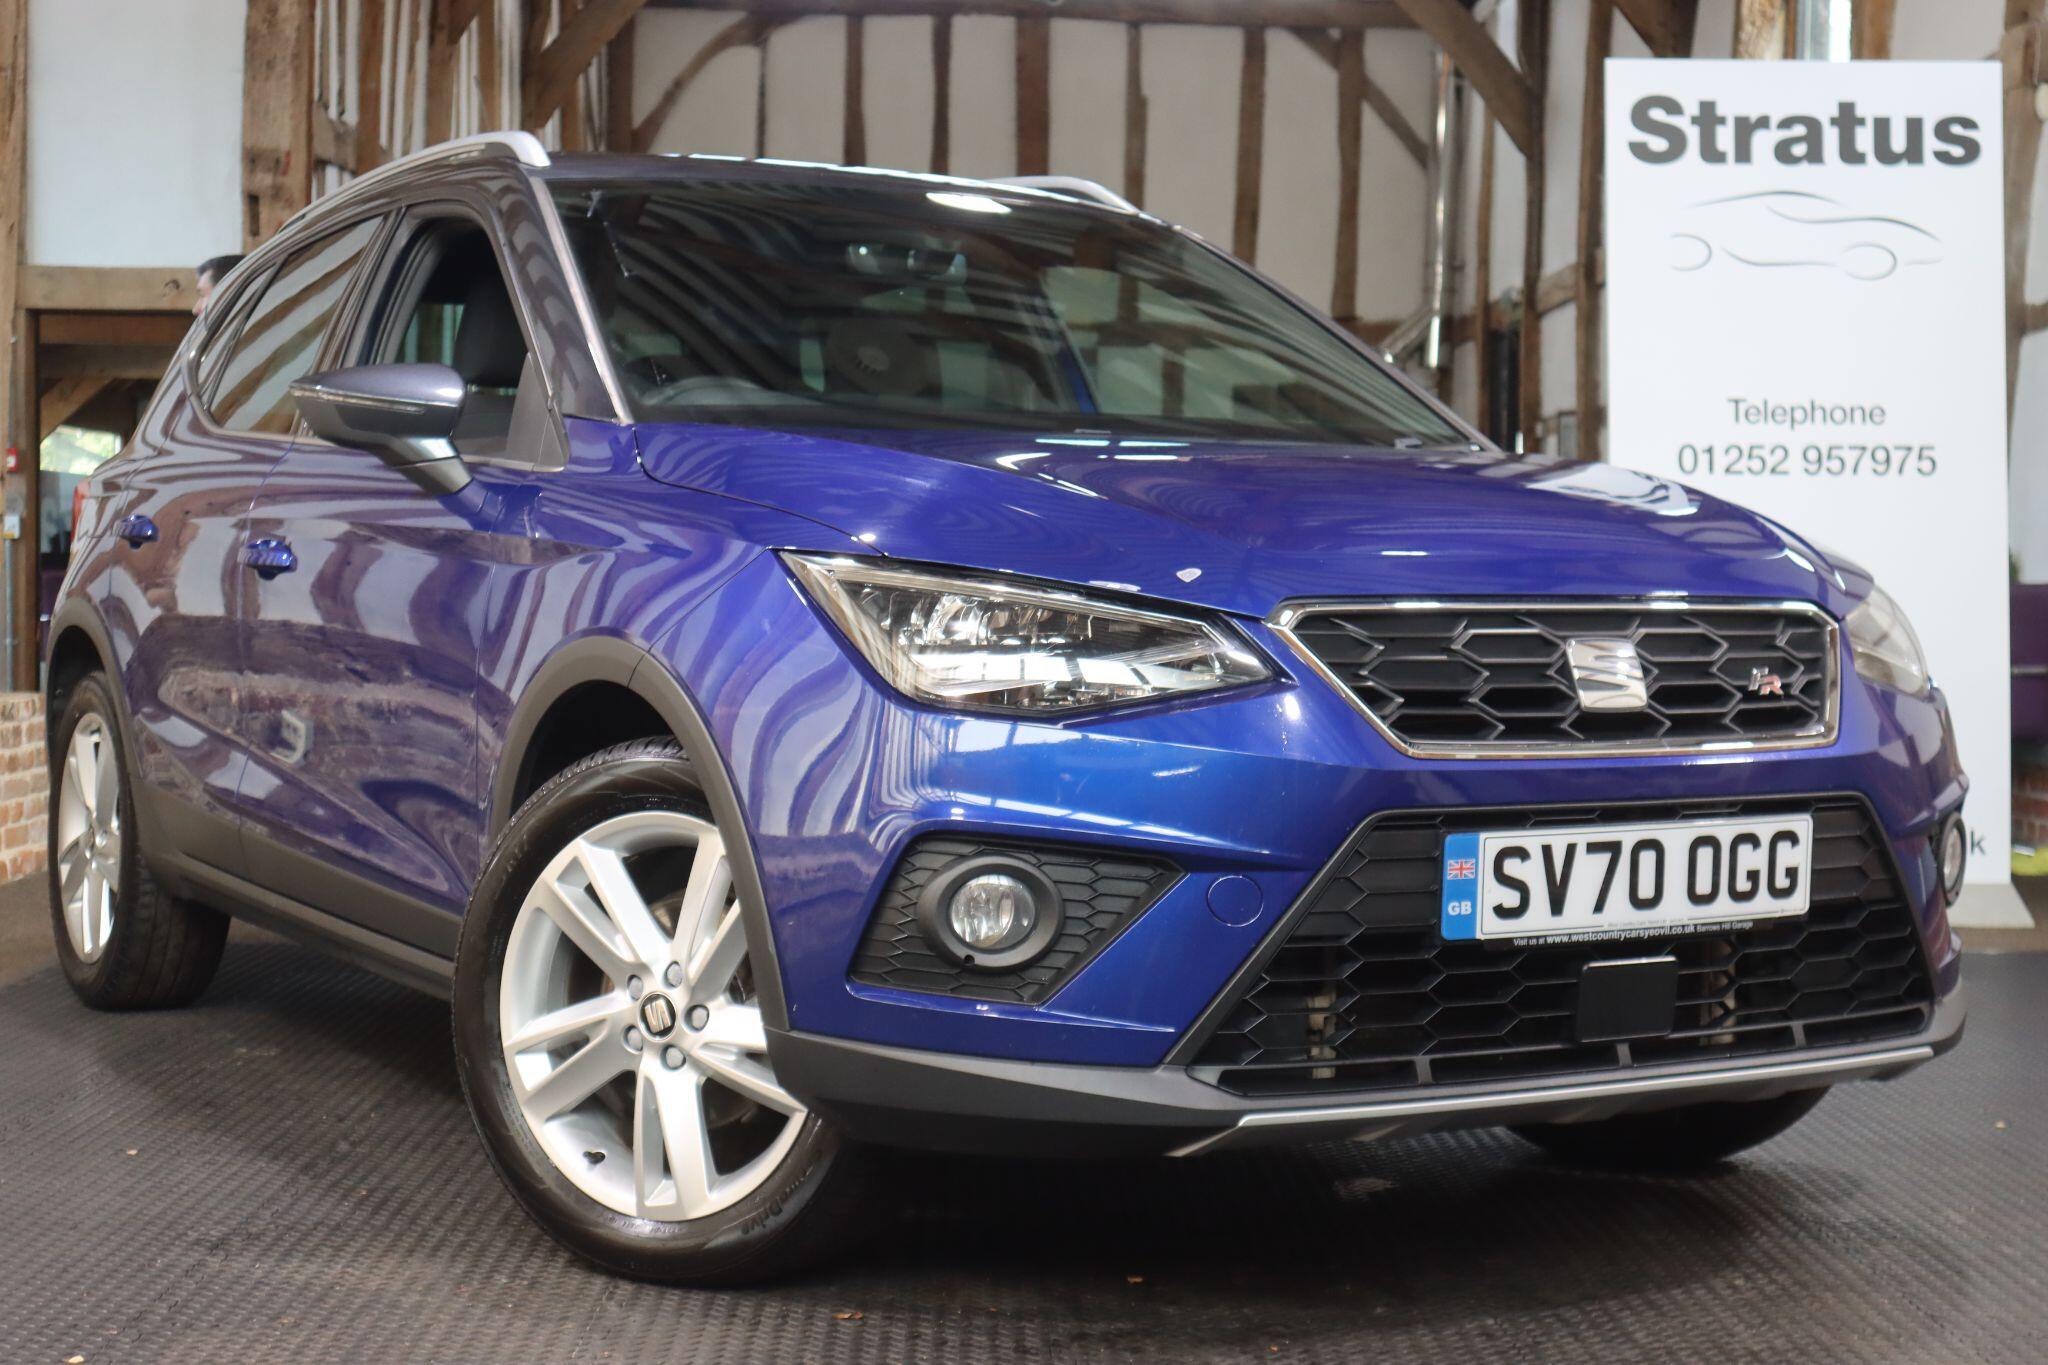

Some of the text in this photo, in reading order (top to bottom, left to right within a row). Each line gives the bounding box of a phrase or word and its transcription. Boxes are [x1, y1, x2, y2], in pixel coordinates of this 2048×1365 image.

[1628, 95, 1982, 166] Stratus
[1727, 398, 1887, 430] Telephone
[1678, 444, 1937, 477] 01252 957975
[1492, 830, 1801, 921] SV70 OGG
[1447, 901, 1472, 916] GB
[1513, 937, 1528, 947] Visit
[1546, 924, 1695, 945] www.westcountrycarsyeovil.co.uk
